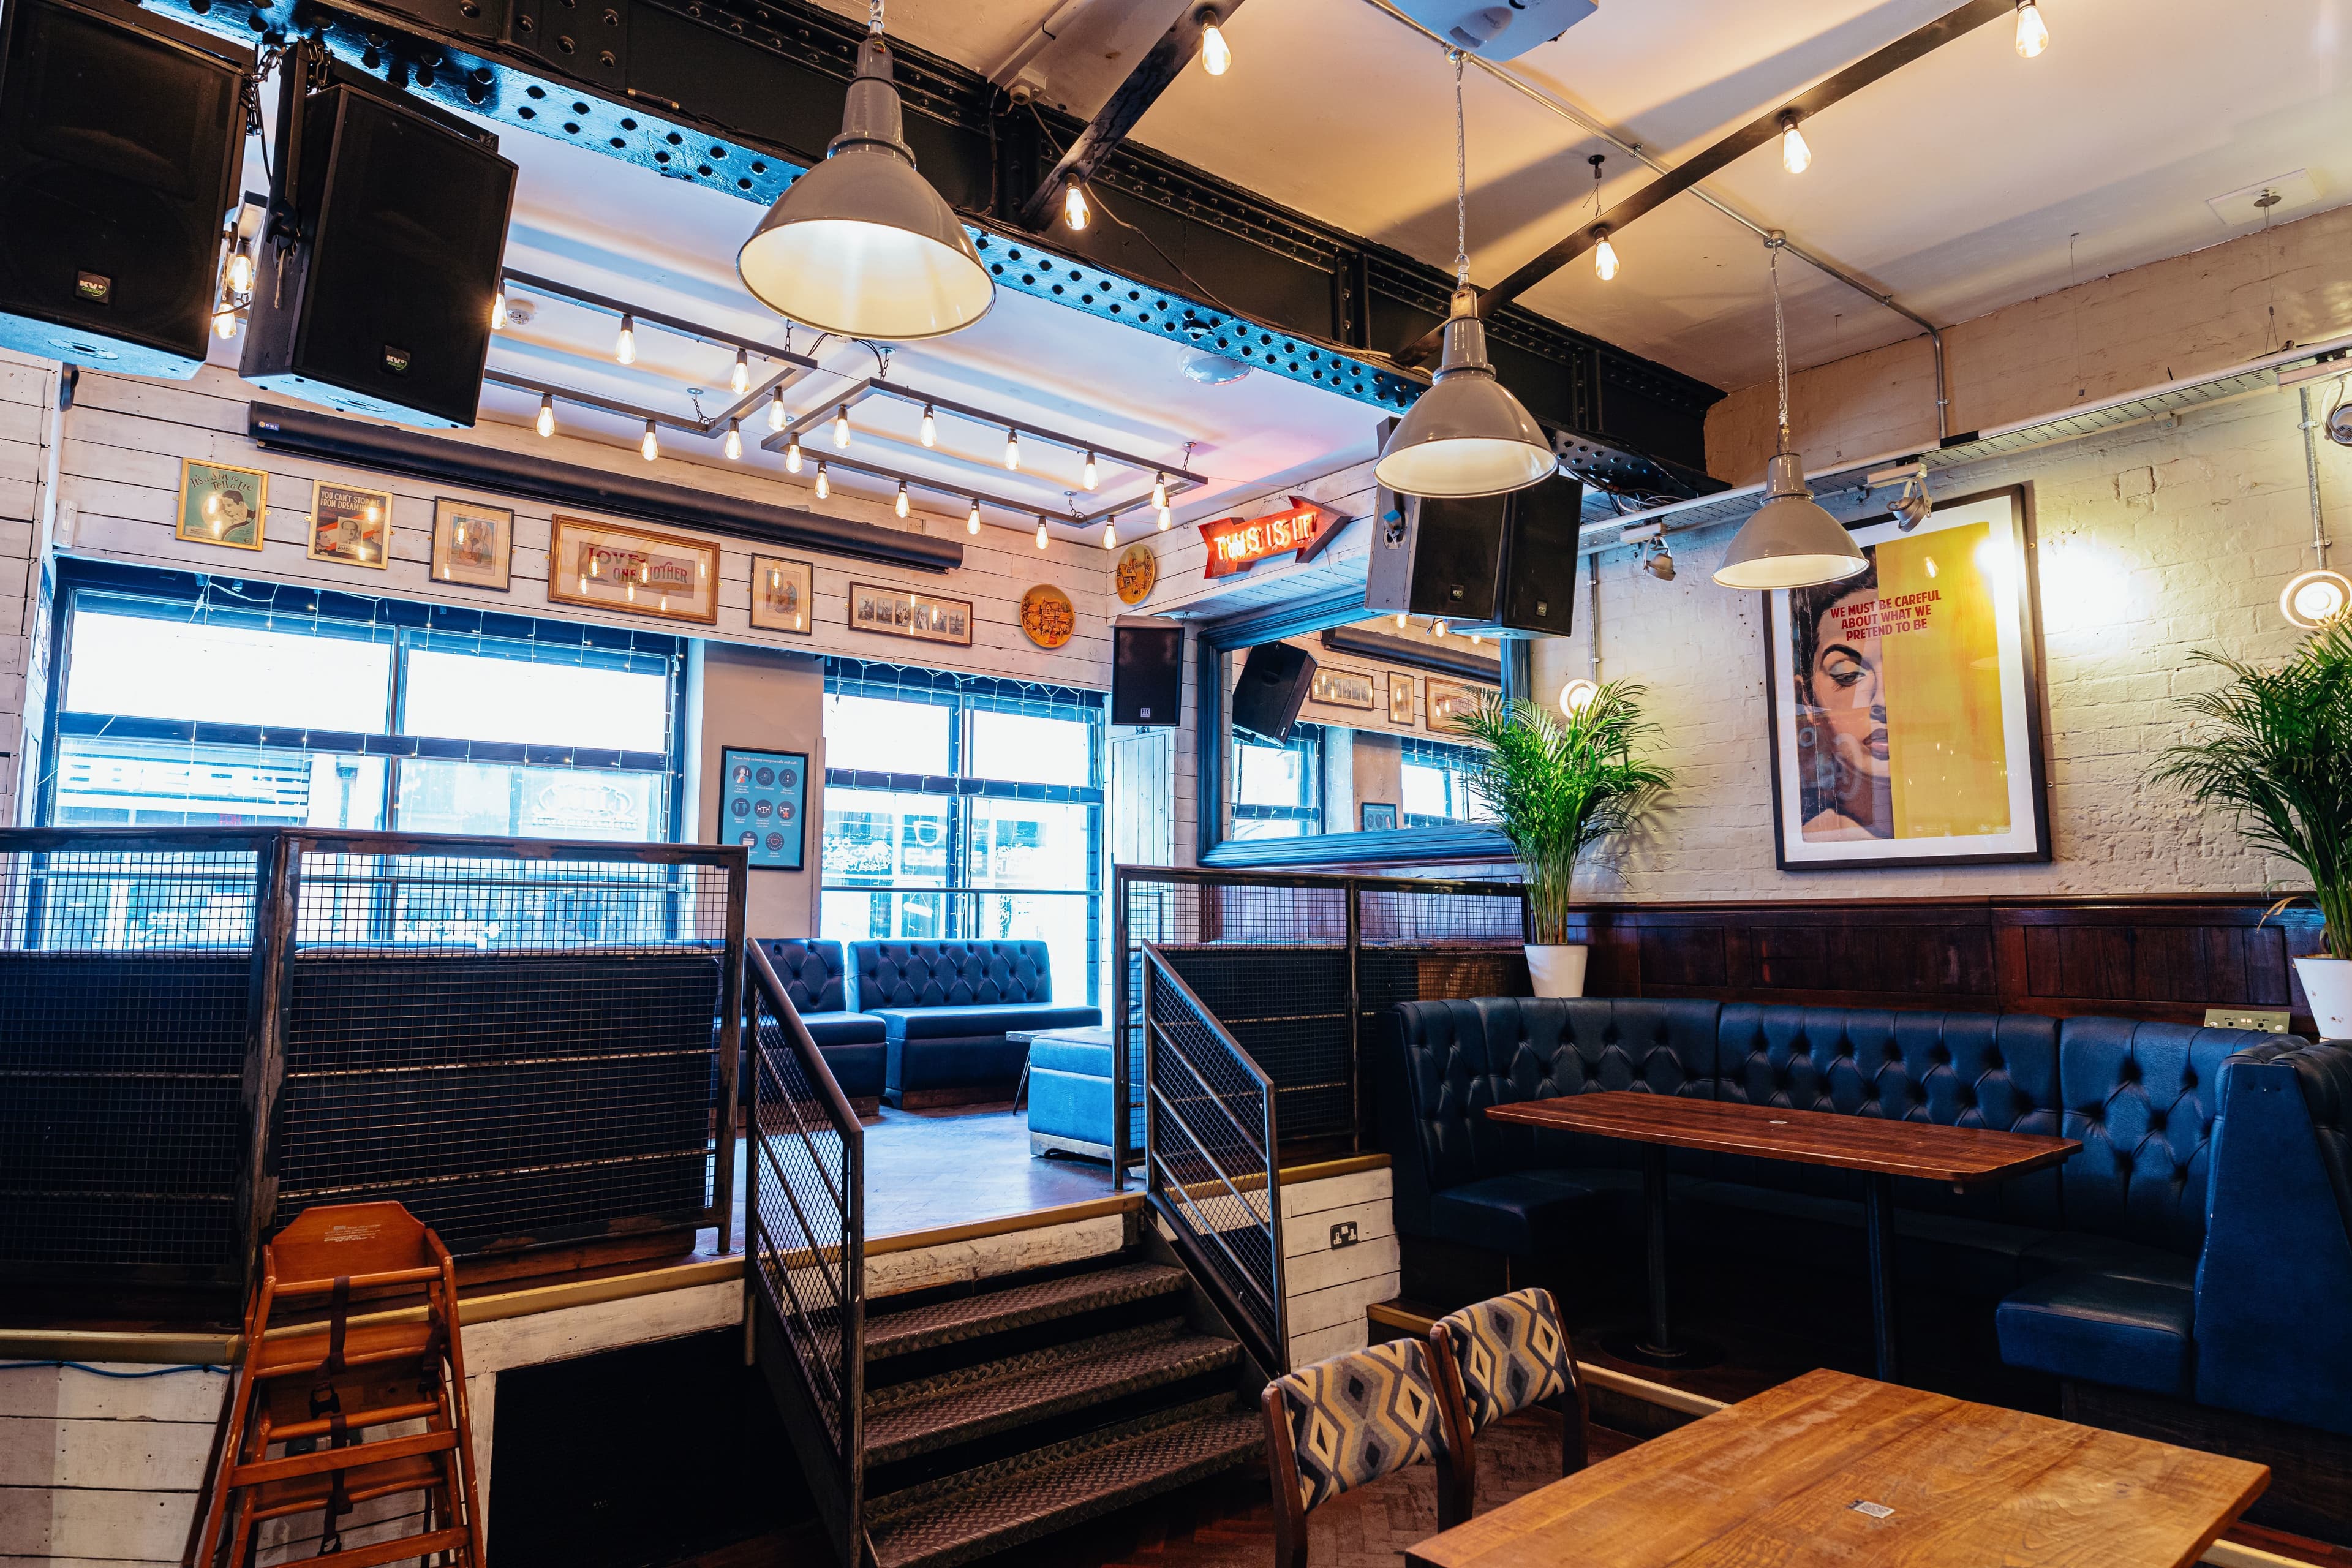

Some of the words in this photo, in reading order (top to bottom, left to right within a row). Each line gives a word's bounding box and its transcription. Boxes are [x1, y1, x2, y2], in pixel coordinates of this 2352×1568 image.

[190, 475, 203, 488] It's
[211, 472, 228, 481] Sin
[211, 480, 228, 491] Tell
[238, 481, 254, 492] Lie
[320, 499, 336, 508] FROM
[337, 502, 371, 512] DREAMIN
[334, 493, 352, 502] CAN'T
[1266, 521, 1285, 547] IS
[1292, 514, 1313, 541] IT
[613, 567, 638, 582] ONE
[637, 562, 687, 584] OTHER
[1830, 607, 1845, 619] WE
[1848, 601, 1875, 616] MUST
[1879, 598, 1892, 609] BE
[1894, 590, 1942, 608] CAREFUL
[1841, 614, 1878, 630] ABOUT
[1881, 608, 1912, 622] WHAT
[1915, 605, 1931, 617] WE
[1846, 625, 1893, 641] PRETEND
[1895, 621, 1910, 633] TO
[1913, 618, 1927, 630] BE
